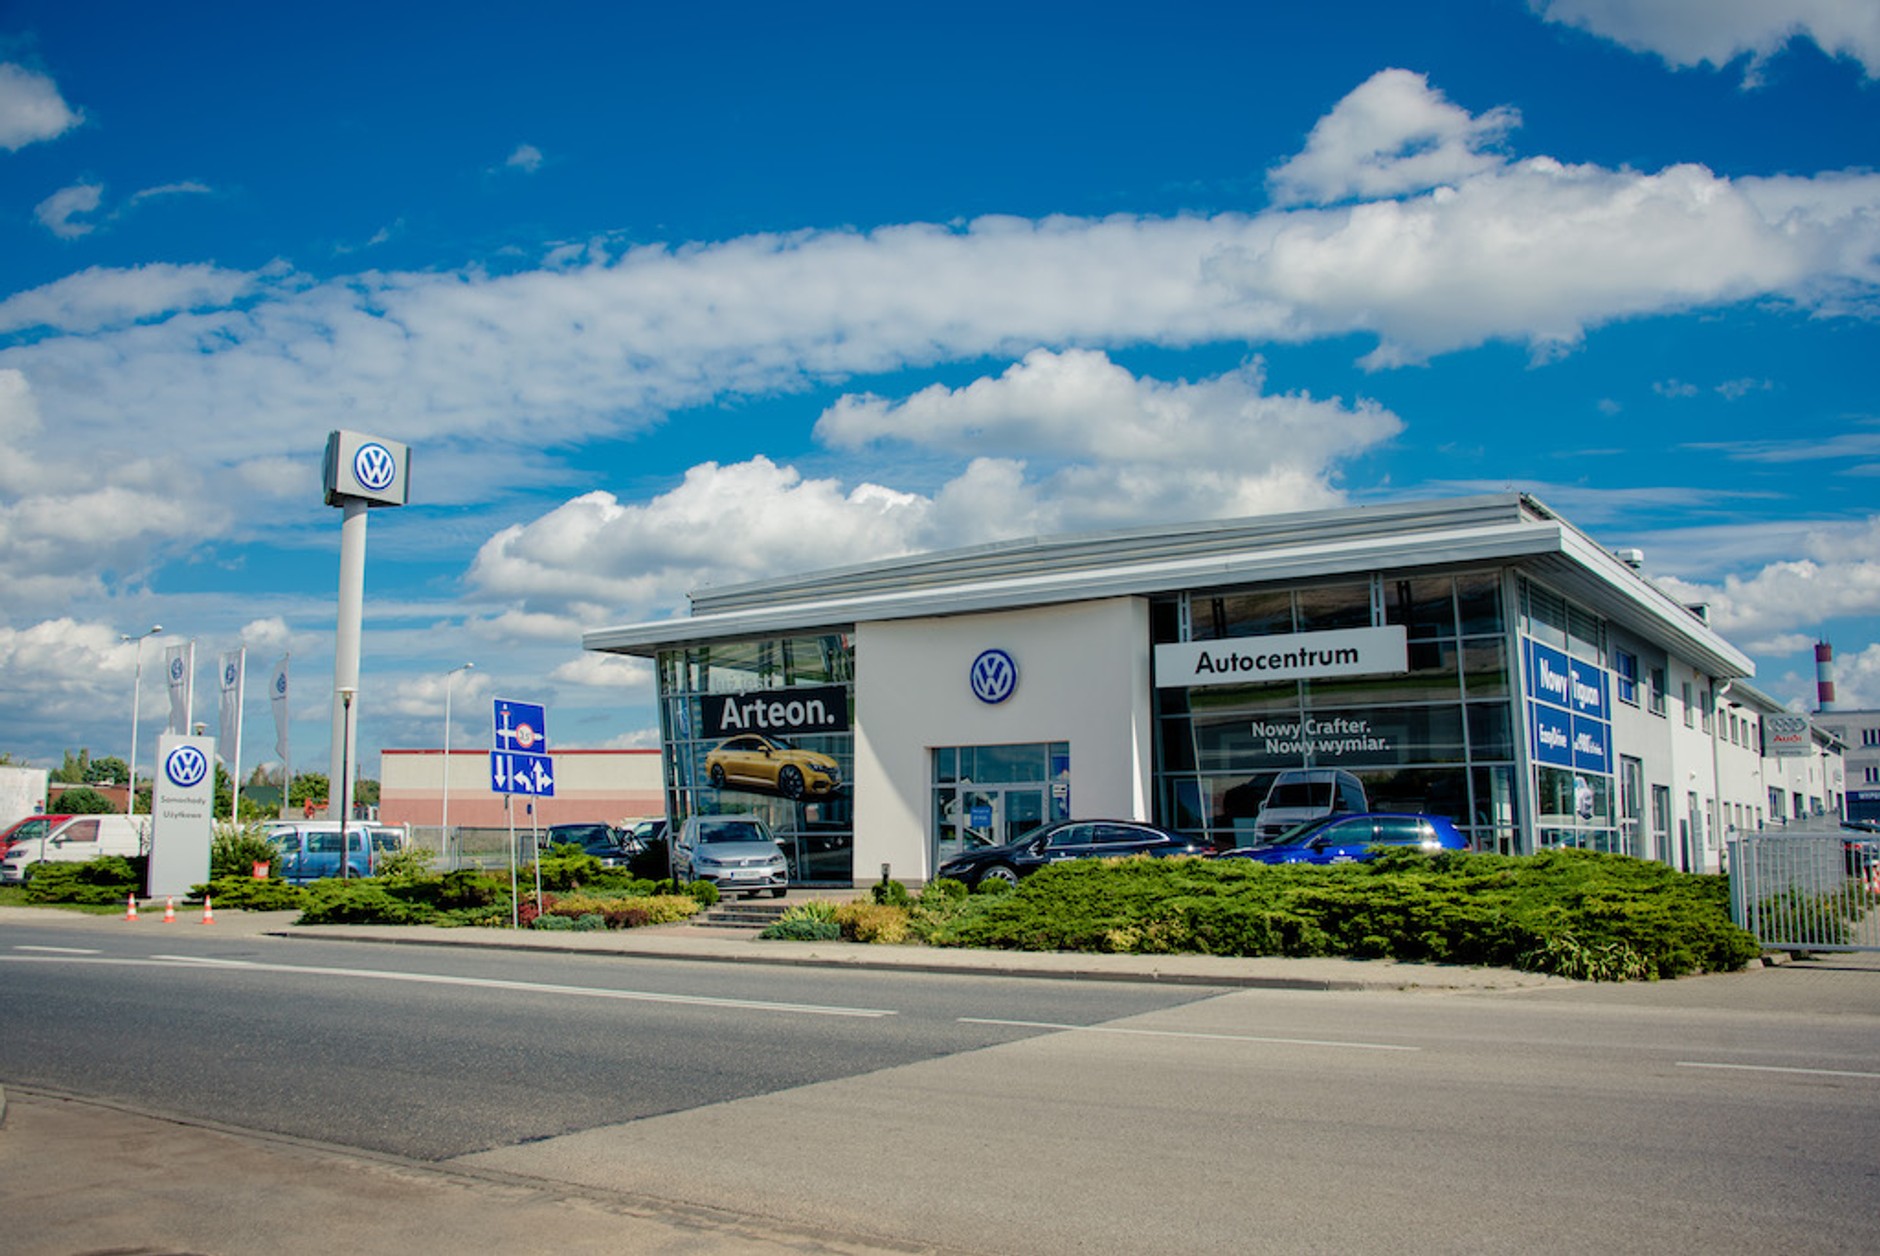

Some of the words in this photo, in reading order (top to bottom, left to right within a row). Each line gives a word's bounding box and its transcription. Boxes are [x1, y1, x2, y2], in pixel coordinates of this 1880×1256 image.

[1195, 647, 1359, 674] Autocentrum
[1539, 657, 1568, 703] Nowy
[1571, 669, 1600, 710] Tiguan
[720, 696, 836, 730] Arteon.
[1251, 721, 1301, 740] Nowy
[1305, 718, 1371, 735] Crafter.
[1265, 738, 1316, 756] Nowy
[1319, 734, 1391, 756] wymiar.
